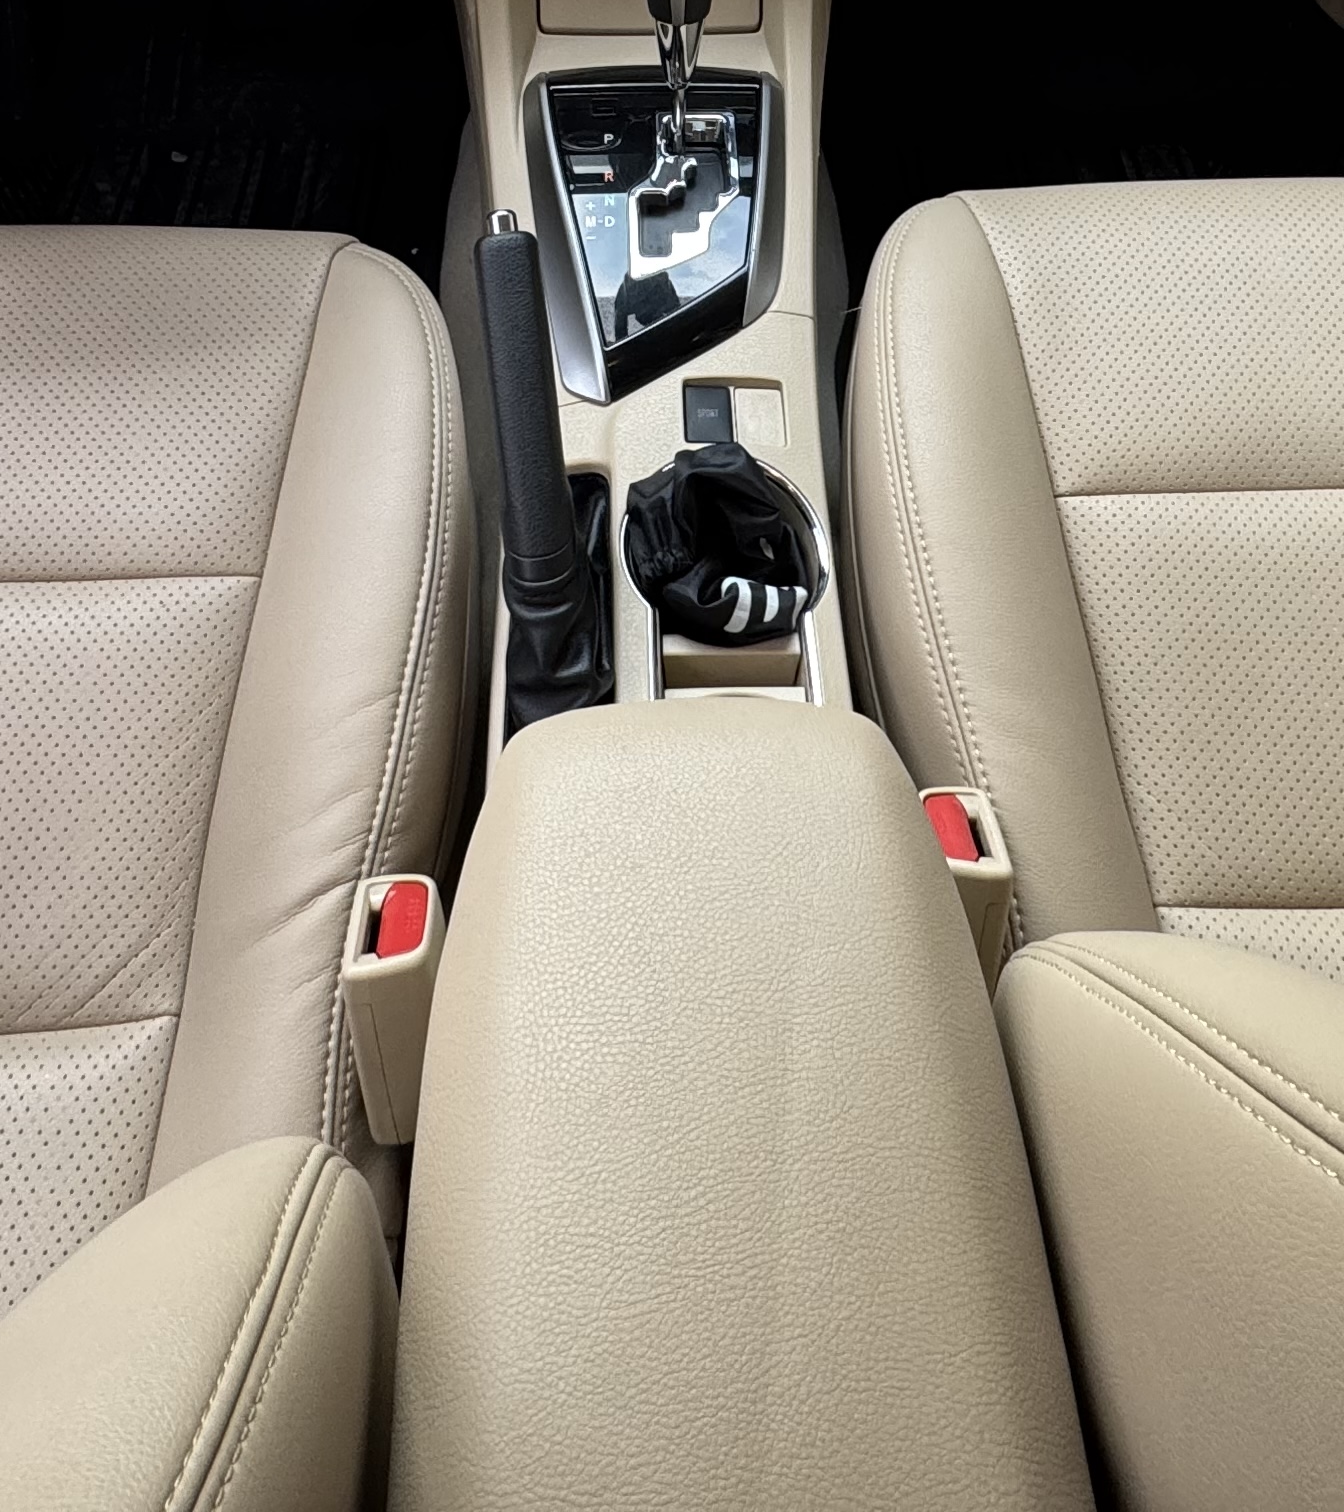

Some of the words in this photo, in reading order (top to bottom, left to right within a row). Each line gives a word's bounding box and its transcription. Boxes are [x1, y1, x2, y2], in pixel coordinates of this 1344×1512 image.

[604, 134, 614, 144] P
[604, 172, 614, 182] R
[604, 194, 615, 206] N
